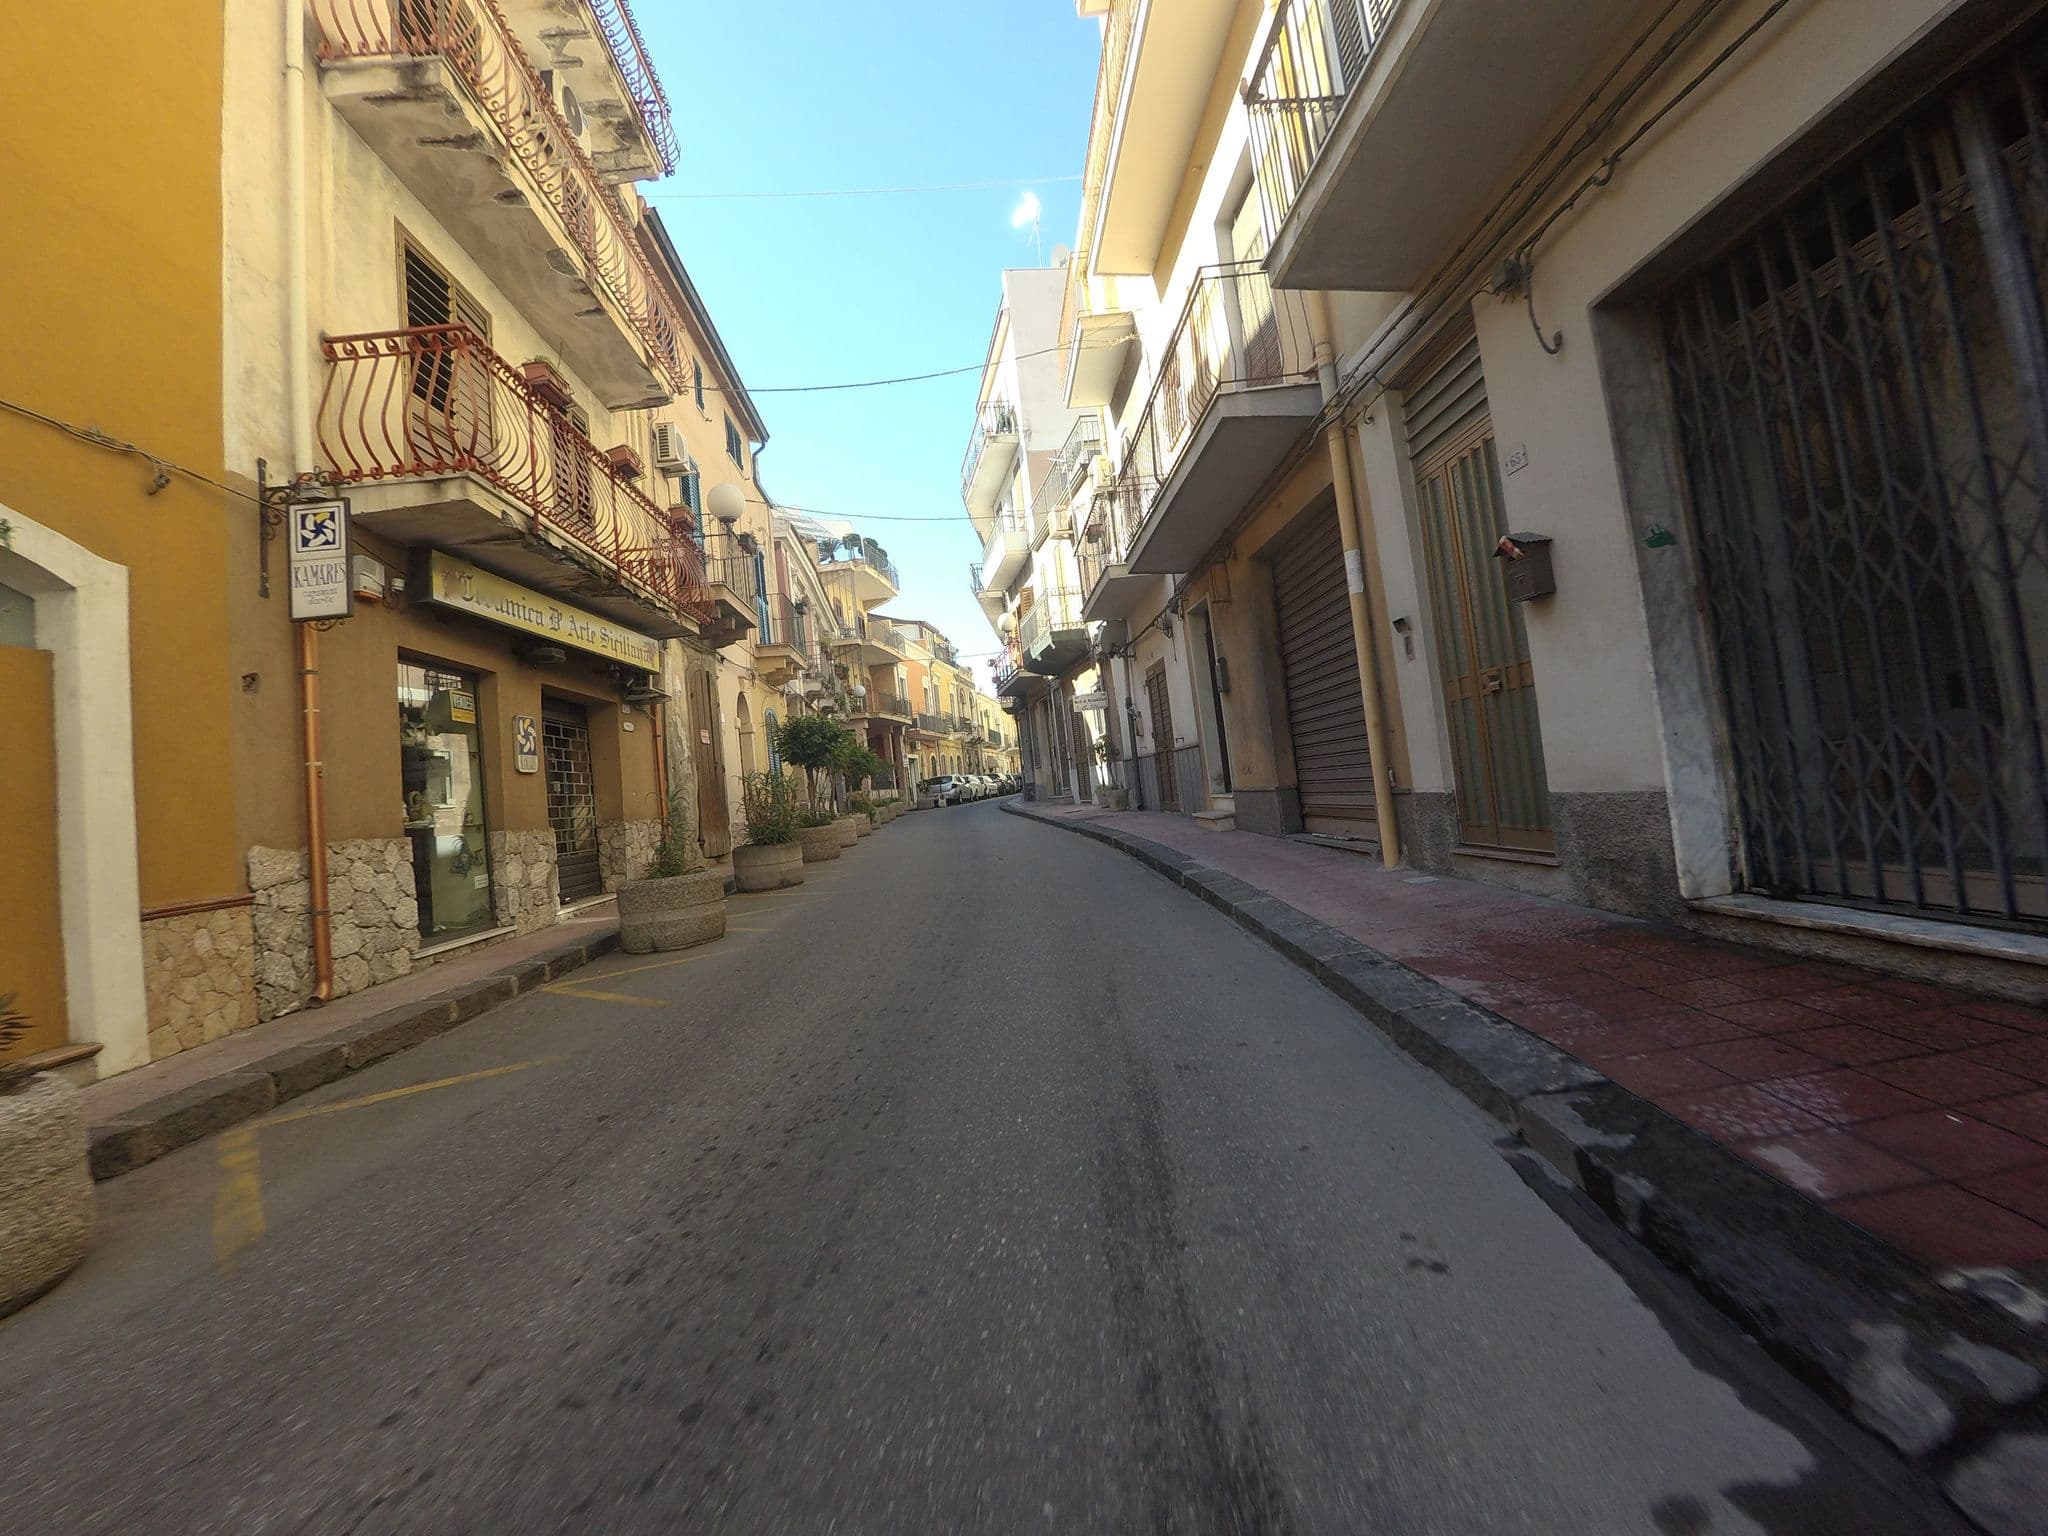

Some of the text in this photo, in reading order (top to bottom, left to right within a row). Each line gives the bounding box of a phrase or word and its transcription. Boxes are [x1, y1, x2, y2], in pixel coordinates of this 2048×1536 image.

[293, 562, 346, 588] KAMARES
[457, 571, 544, 627] Camica
[567, 615, 596, 643] Arte
